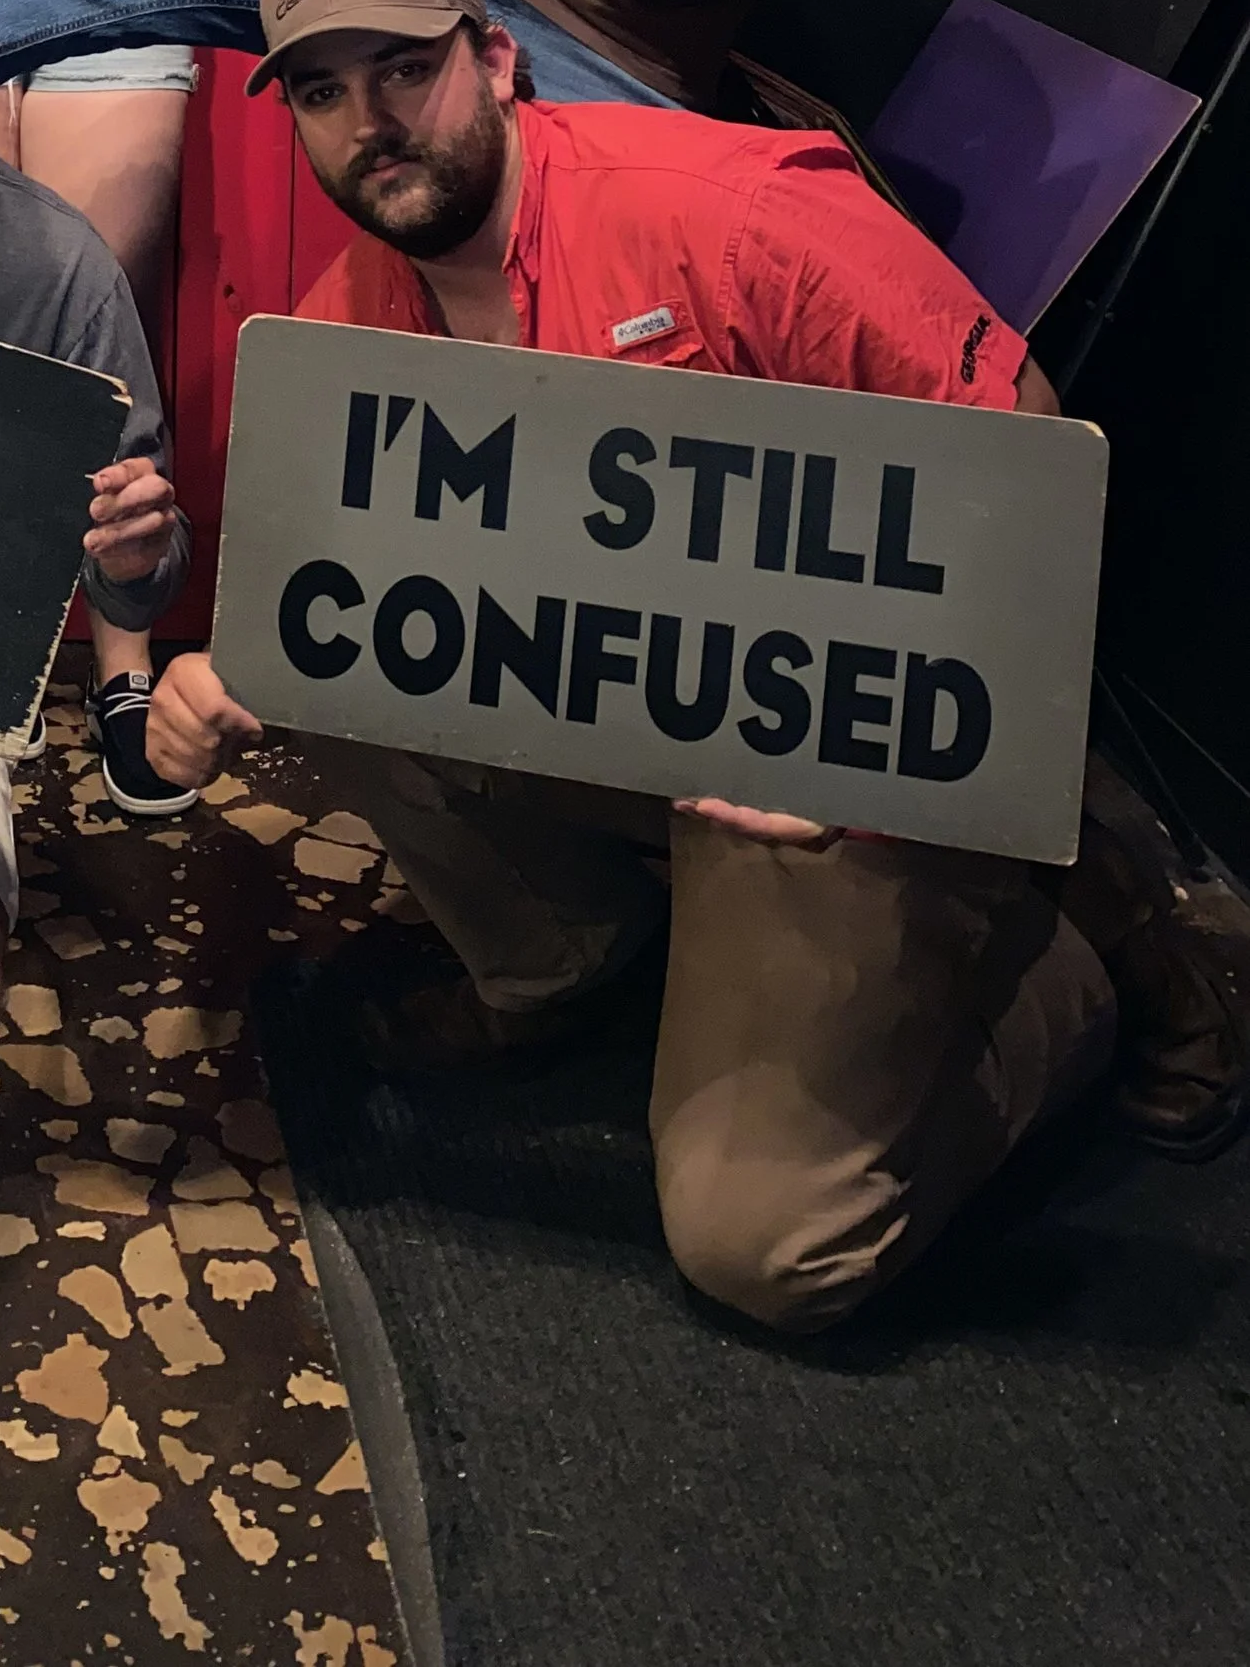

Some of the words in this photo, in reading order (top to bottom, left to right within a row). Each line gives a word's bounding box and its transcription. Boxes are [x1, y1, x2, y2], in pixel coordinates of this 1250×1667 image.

[341, 391, 517, 532] I'M
[582, 427, 945, 595] STILL
[278, 559, 992, 783] CONFUSED
